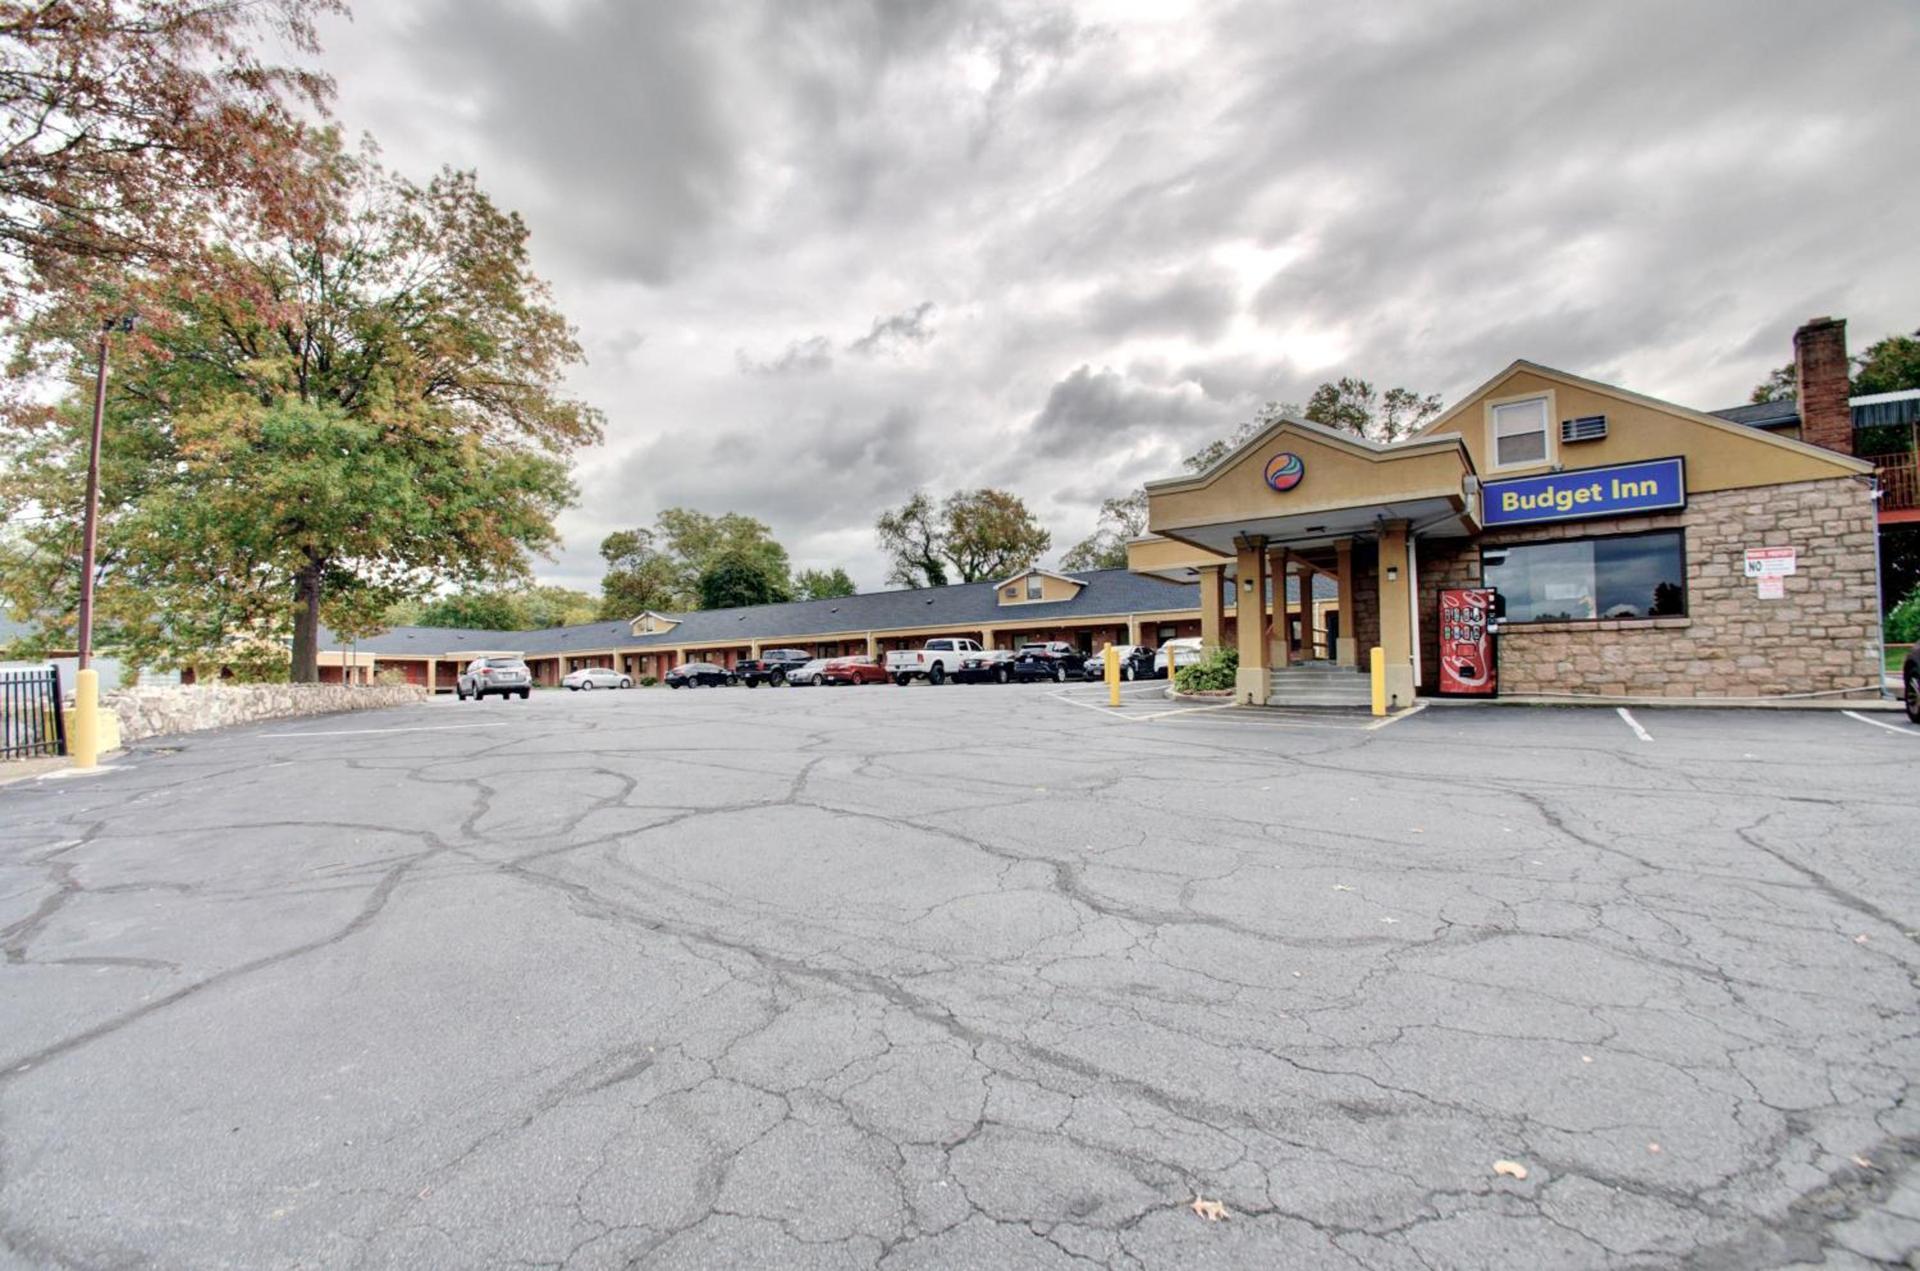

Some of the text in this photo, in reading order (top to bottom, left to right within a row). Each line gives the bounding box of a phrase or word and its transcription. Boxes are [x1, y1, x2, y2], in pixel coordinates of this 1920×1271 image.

[1502, 479, 1658, 512] Budget Inn
[1748, 560, 1762, 573] NO
